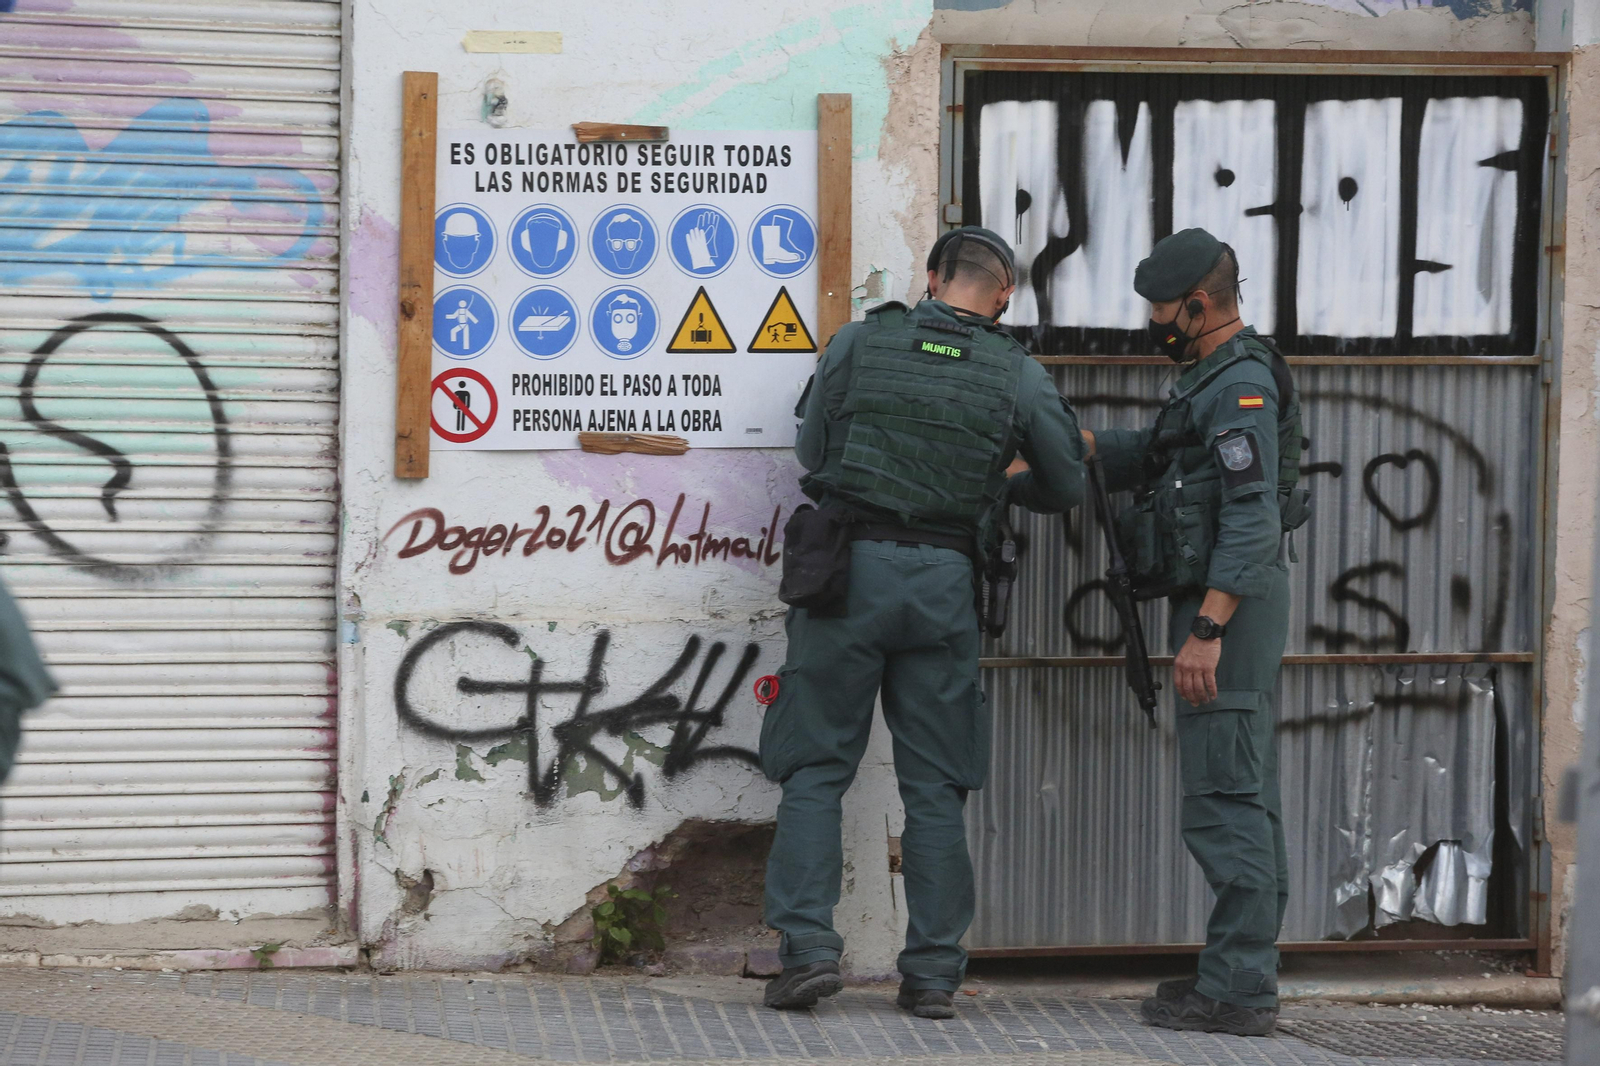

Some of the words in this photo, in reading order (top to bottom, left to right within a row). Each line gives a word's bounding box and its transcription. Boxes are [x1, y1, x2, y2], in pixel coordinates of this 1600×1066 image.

[450, 142, 475, 165] ES
[485, 142, 628, 166] OBLIGATORIO
[637, 143, 715, 167] SEGUIR
[724, 144, 792, 168] TODAS
[475, 171, 513, 193] LAS
[522, 171, 608, 193] NORMAS
[617, 172, 642, 193] DE
[650, 171, 768, 194] SEGURIDAD
[921, 341, 962, 358] MUNITIS
[511, 373, 595, 396] PROHIBIDO
[600, 373, 618, 396] EL
[623, 374, 662, 397] PASO
[667, 374, 677, 397] A
[682, 374, 722, 397] TODA
[513, 408, 583, 432] PERSONA
[587, 408, 637, 432] AJENA
[641, 409, 652, 432] A
[657, 409, 676, 432] LA
[681, 409, 723, 432] OBRA
